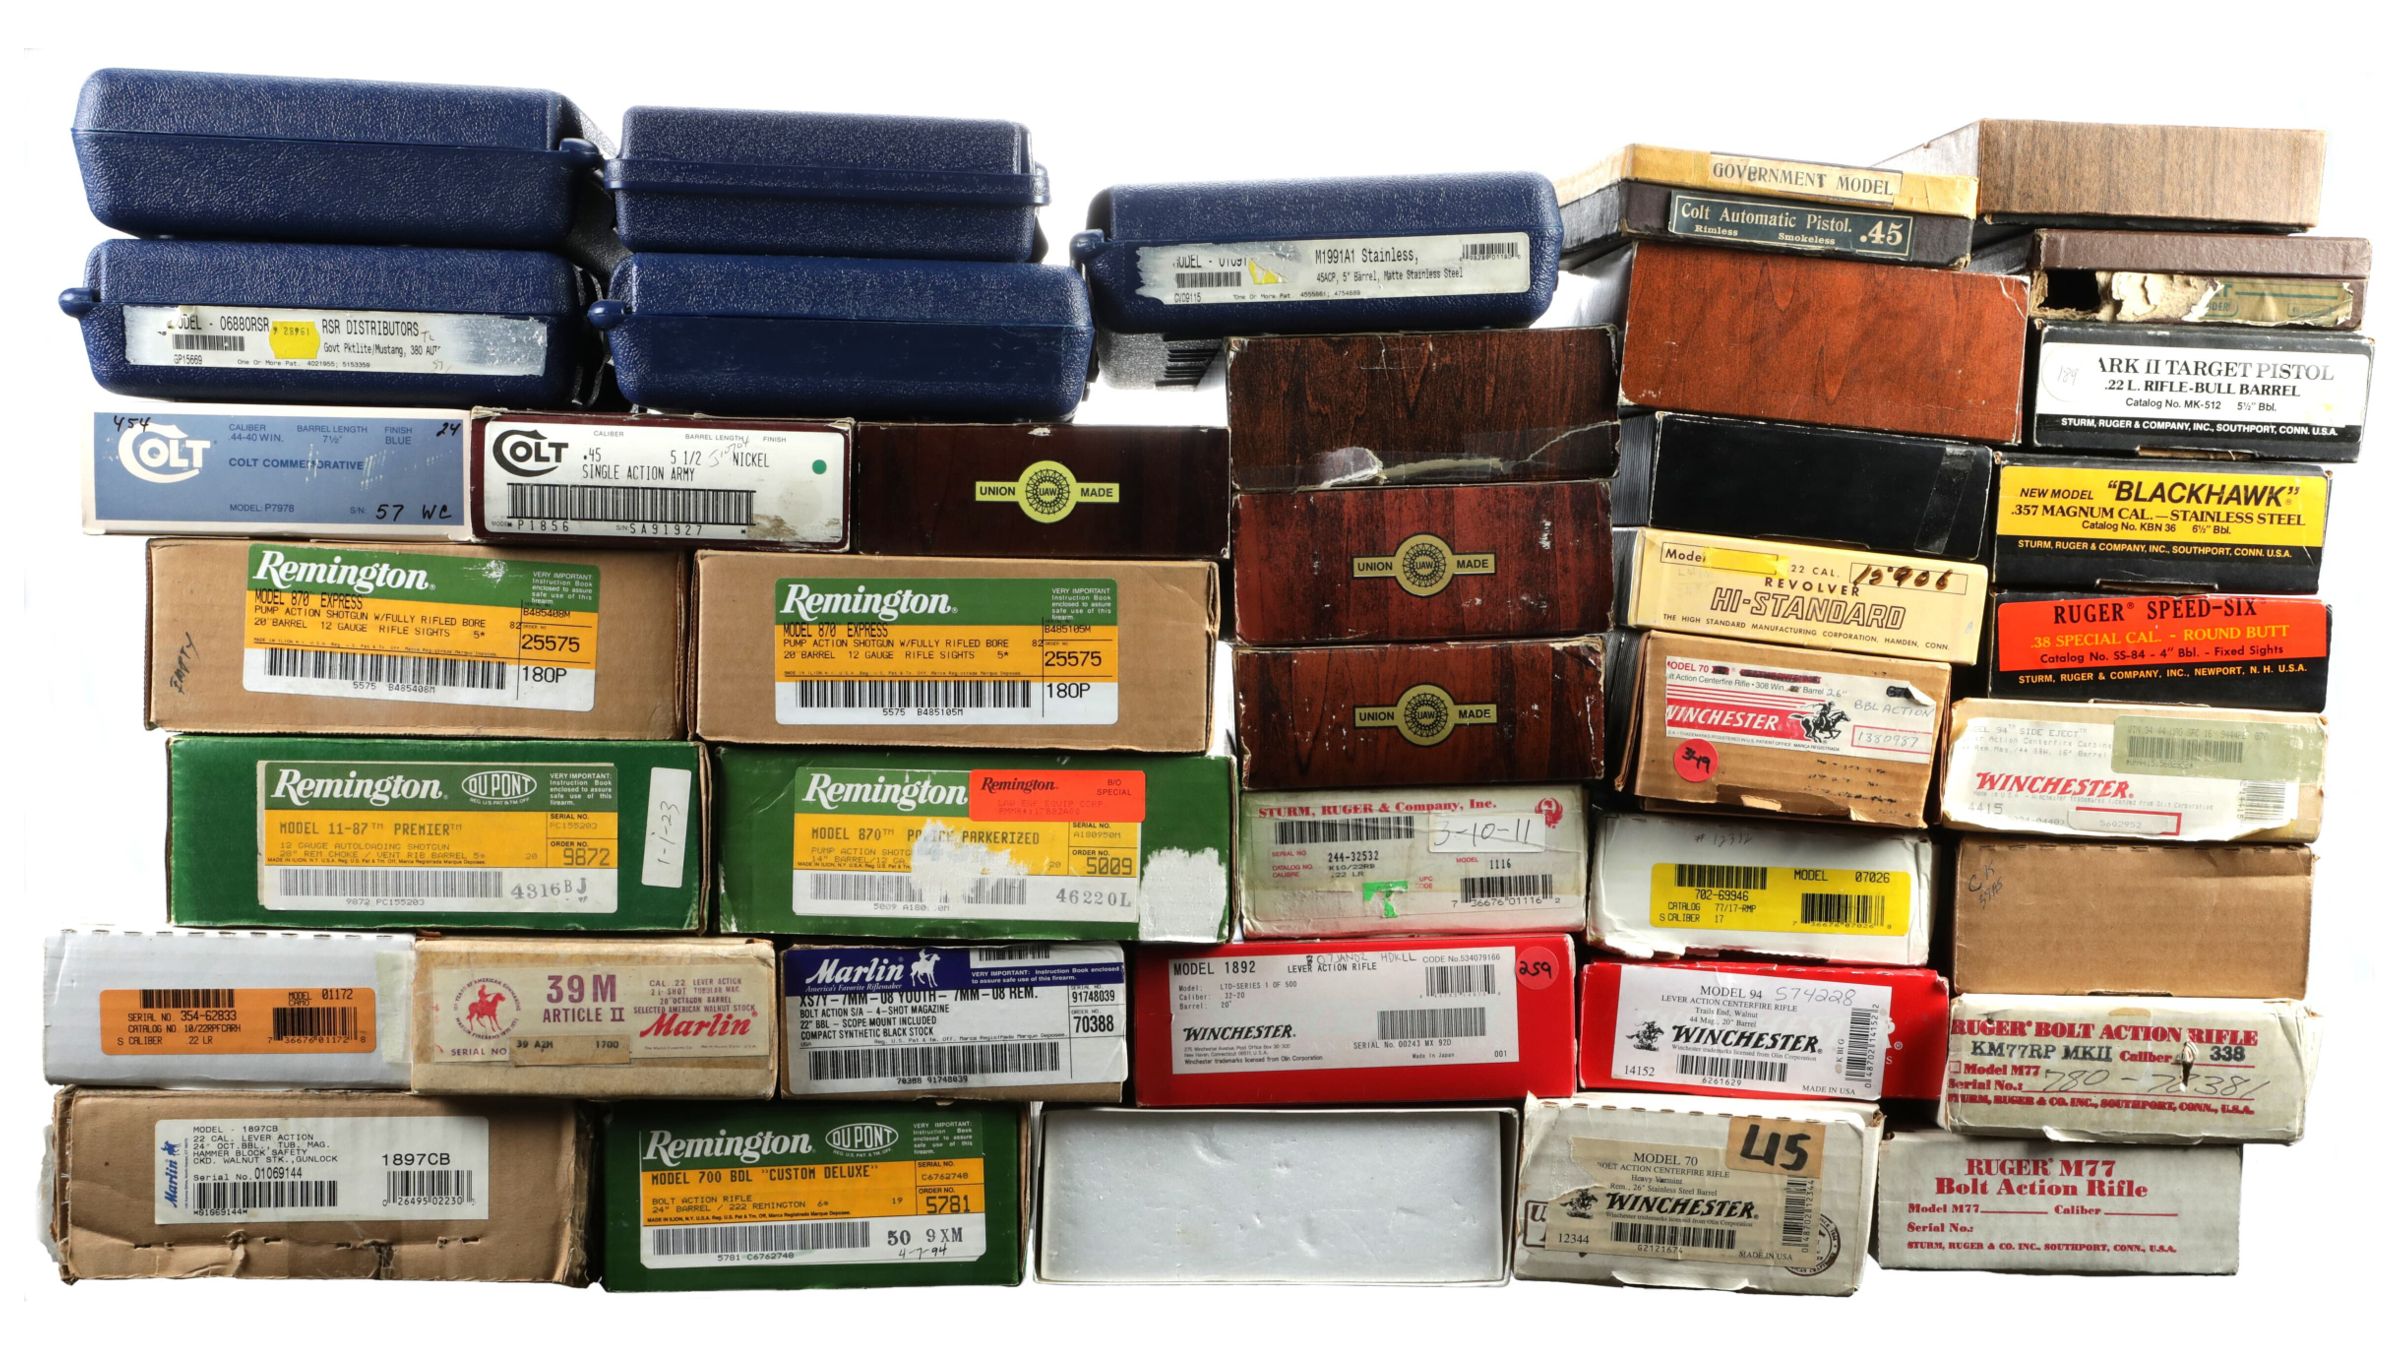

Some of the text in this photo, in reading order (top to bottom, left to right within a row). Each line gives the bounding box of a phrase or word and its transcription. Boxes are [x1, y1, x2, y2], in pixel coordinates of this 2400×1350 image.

[1836, 171, 1893, 196] MODEL
[1681, 202, 1852, 233] Colt Automatic Pistol.
[1694, 224, 1835, 245] Rimless Smokeless
[1860, 221, 1903, 246] .45
[1315, 248, 1354, 264] M1991A1
[322, 318, 419, 337] RSR DISTRIBUTORS
[2165, 360, 2334, 380] TARGET PISTOL
[2239, 384, 2300, 396] BARREL
[2125, 397, 2221, 410] Catalog MK-512
[228, 423, 413, 435] CALIBER BARREL LENGTH FINISH
[2098, 419, 2132, 428] RUGER
[385, 436, 412, 445] BLUE
[118, 422, 211, 483] COLT
[492, 430, 569, 478] COLT
[733, 451, 769, 468] NICKEL
[582, 464, 695, 482] SINGLE ACTION ARMY
[980, 486, 1113, 497] UNION MADE
[2020, 488, 2049, 498] NEW
[2050, 489, 2094, 500] MODEL
[2042, 505, 2305, 526] MAGNUM STAINLESS STEEL
[2082, 520, 2176, 532] Catalog KBN 36
[252, 550, 429, 595] Remington
[1357, 559, 1489, 572] UNION MADE
[1765, 577, 1861, 597] REVOLVER
[320, 593, 364, 610] EXPRESS
[779, 584, 951, 621] Remington
[1710, 587, 1906, 631] HI-STANDARD
[284, 607, 486, 628] ACTION SHOTGUN BORE
[2054, 603, 2124, 624] RUGER
[783, 622, 889, 638] MODEL EXPRESS
[1663, 613, 1676, 621] THE
[1706, 618, 1746, 628] STANDARD
[1751, 623, 1817, 636] MANUFACTURING
[521, 634, 580, 653] 25575
[2056, 625, 2289, 647] SPECIAL ROUND BUTT
[865, 650, 975, 660] GAUGE RIFLE SIGHTS
[1045, 651, 1102, 667] 25575
[2040, 645, 2283, 664] Catalog Fixed Sights
[523, 666, 567, 683] 180P
[1047, 682, 1091, 698] 180P
[1359, 709, 1491, 722] UNION MADE
[270, 769, 443, 807] Remington
[802, 773, 968, 811] Remington
[1976, 772, 2129, 799] WINCHESTER
[1321, 803, 1373, 815] RUGER
[280, 821, 319, 835] MODEL
[811, 827, 1039, 845] MODEL PARKERIZED
[563, 847, 610, 866] 9872
[1328, 850, 1379, 863] 244-32532
[1490, 858, 1511, 870] 1116
[1086, 856, 1132, 876] 5009
[1794, 869, 1890, 883] MODEL 07026
[1695, 888, 1749, 901] 702-69946
[805, 957, 904, 984] Marlin
[1173, 960, 1255, 975] MODEL 1892
[1287, 962, 1377, 973] LEVER ACTION RIFLE
[547, 974, 616, 1003] 39 M
[1072, 989, 1115, 1003] 91748039
[1700, 985, 1762, 1000] MODEL 94
[180, 1010, 237, 1021] 354-62833
[543, 1007, 602, 1023] ARTICLE
[799, 1004, 949, 1019] BOLT ACTION MAGAZINE
[842, 1015, 937, 1028] SCOPE MOUNT INCLUDED
[1073, 1014, 1114, 1033] 70388
[800, 1026, 934, 1041] COMPACT SYNTHETIC BLACK STOCK
[1183, 1024, 1292, 1042] WINCHESTER
[2034, 1022, 2095, 1039] BOLT
[2099, 1024, 2182, 1043] ACTION
[451, 1048, 485, 1056] SERIAL
[1971, 1040, 2056, 1059] KM77RP
[2209, 1046, 2246, 1062] 338
[1625, 1065, 1655, 1077] 14152
[1963, 1063, 2008, 1075] Model
[1829, 1086, 1838, 1094] IN
[1838, 1087, 1856, 1096] USA
[277, 1133, 314, 1141] ACTION
[642, 1129, 813, 1167] Remington
[382, 1153, 450, 1166] 1897CB
[1633, 1152, 1698, 1166] MODEL 70
[254, 1166, 302, 1180] 01069144
[2059, 1159, 2116, 1177] M77
[651, 1171, 722, 1185] MODEL 700
[1935, 1177, 2148, 1197] Bolt Action Rifle
[926, 1194, 971, 1215] 5781
[1606, 1192, 1755, 1219] WINCHESTER
[1908, 1203, 2101, 1215] Model M77 Caliber
[1907, 1221, 1945, 1232] Serial
[1559, 1233, 1589, 1244] 12344
